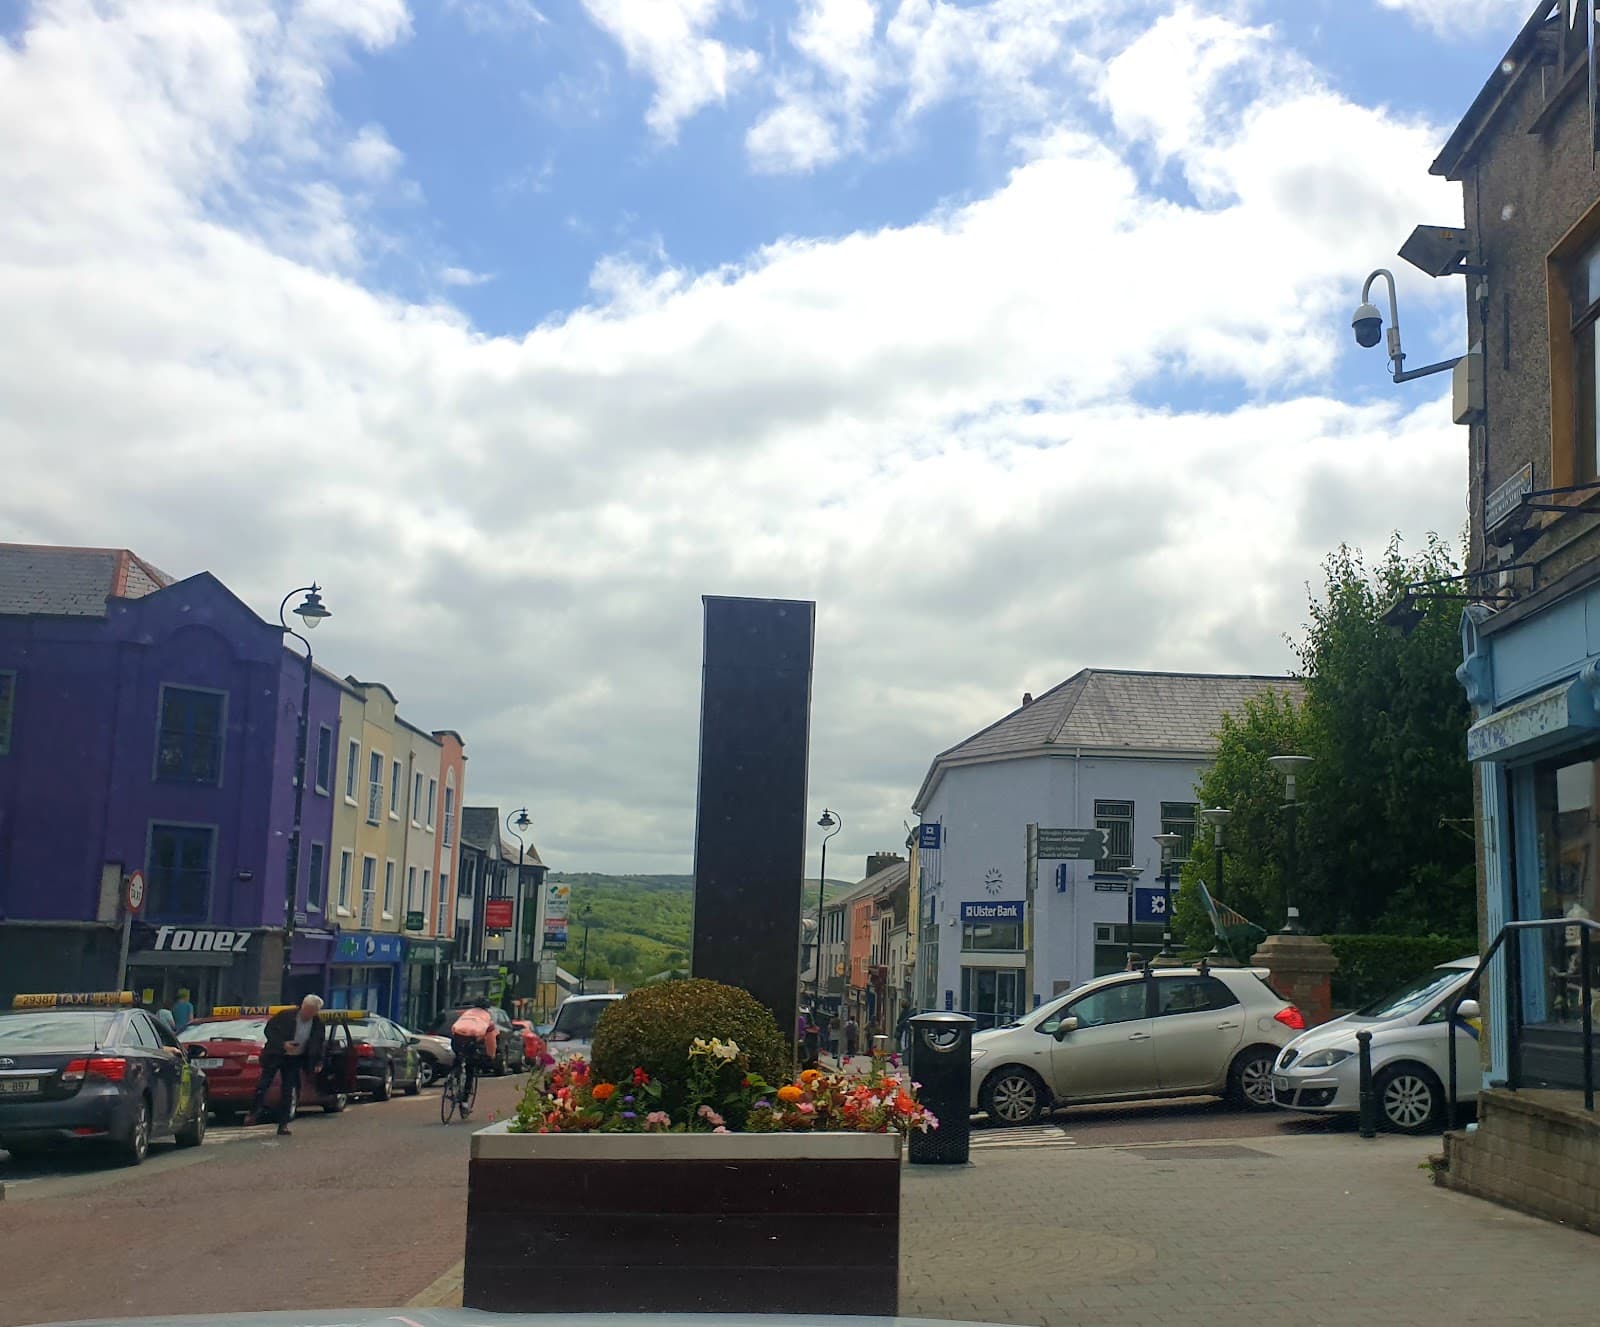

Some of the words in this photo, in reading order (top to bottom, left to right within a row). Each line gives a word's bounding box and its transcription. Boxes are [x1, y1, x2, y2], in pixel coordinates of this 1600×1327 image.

[973, 905, 996, 917] Ulster
[997, 904, 1018, 917] Bank
[154, 925, 251, 952] fonez
[60, 993, 88, 1004] TAXI
[243, 1006, 267, 1015] TAXI
